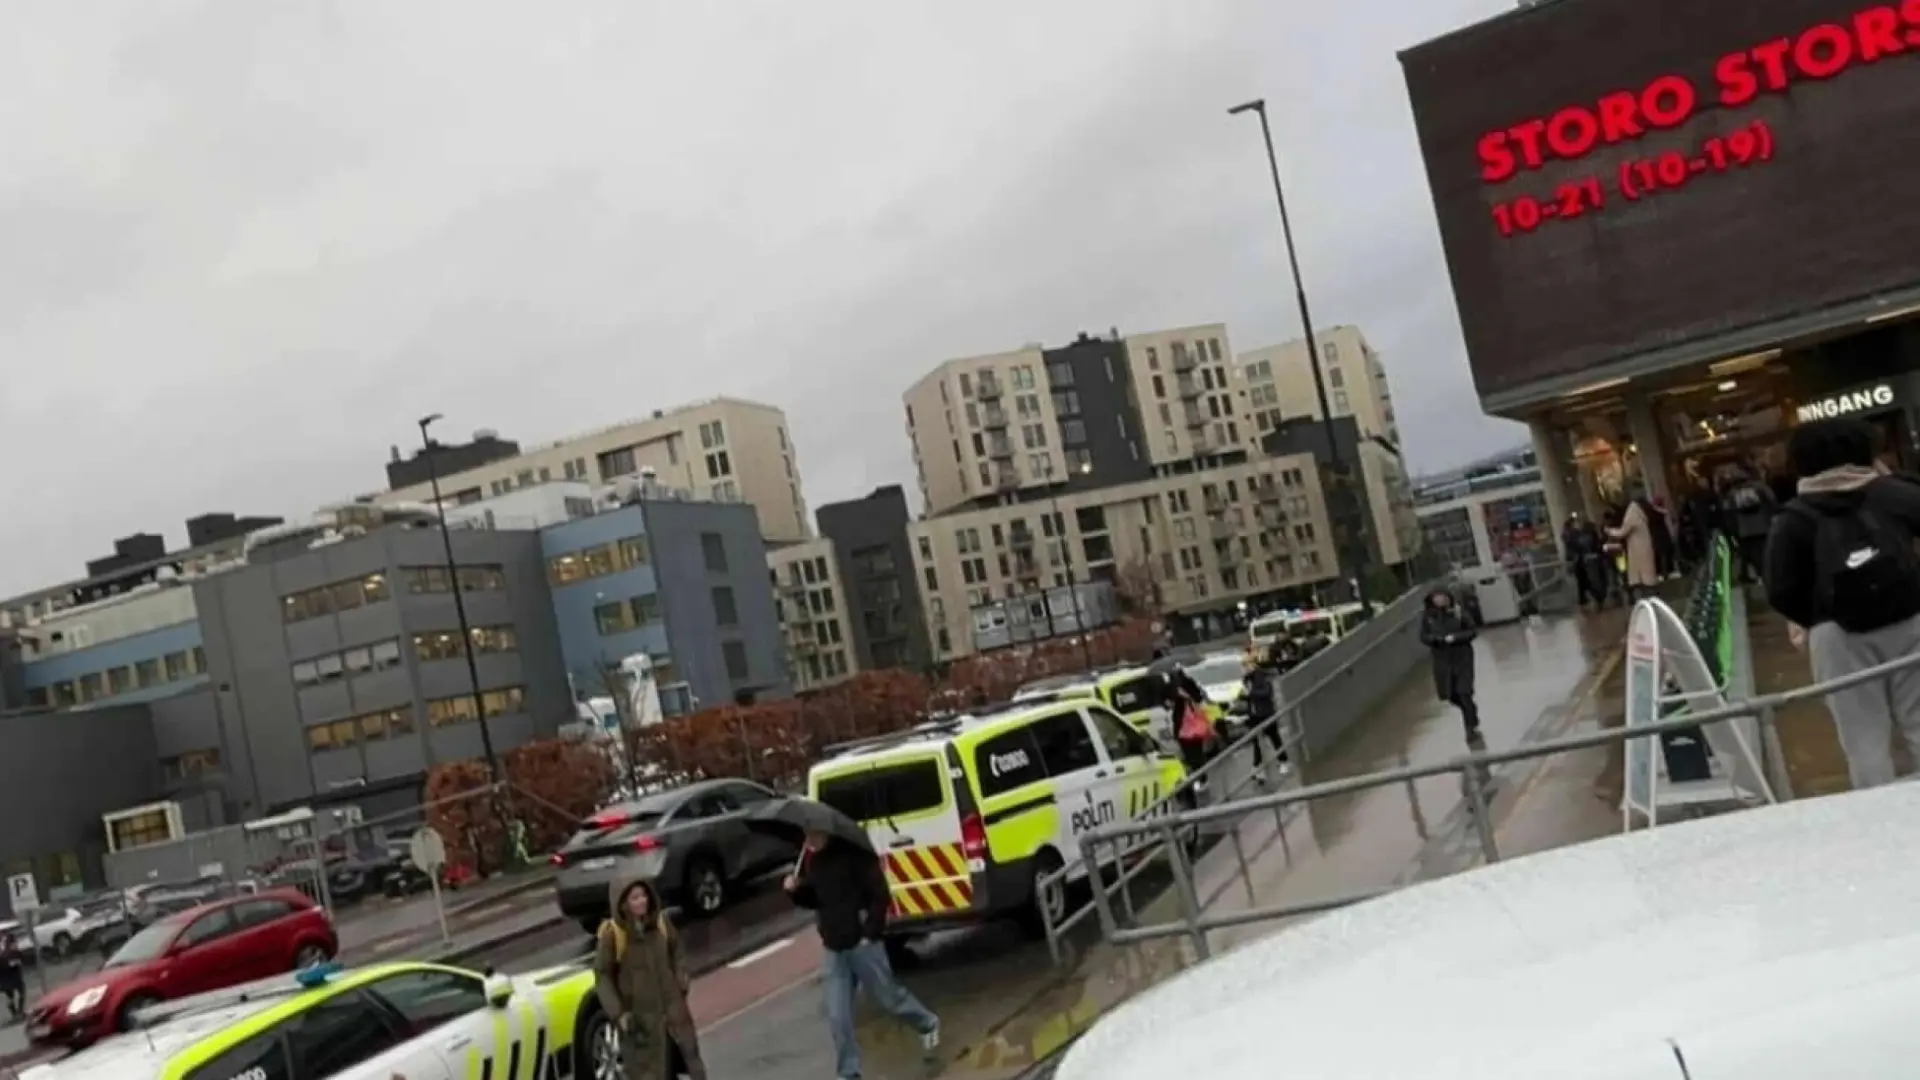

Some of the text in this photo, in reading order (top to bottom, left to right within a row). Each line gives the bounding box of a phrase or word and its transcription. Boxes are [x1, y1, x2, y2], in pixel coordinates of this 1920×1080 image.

[1477, 77, 1696, 181] STORO
[1493, 120, 1773, 234] 10-21 (10-19)
[15, 878, 29, 897] P
